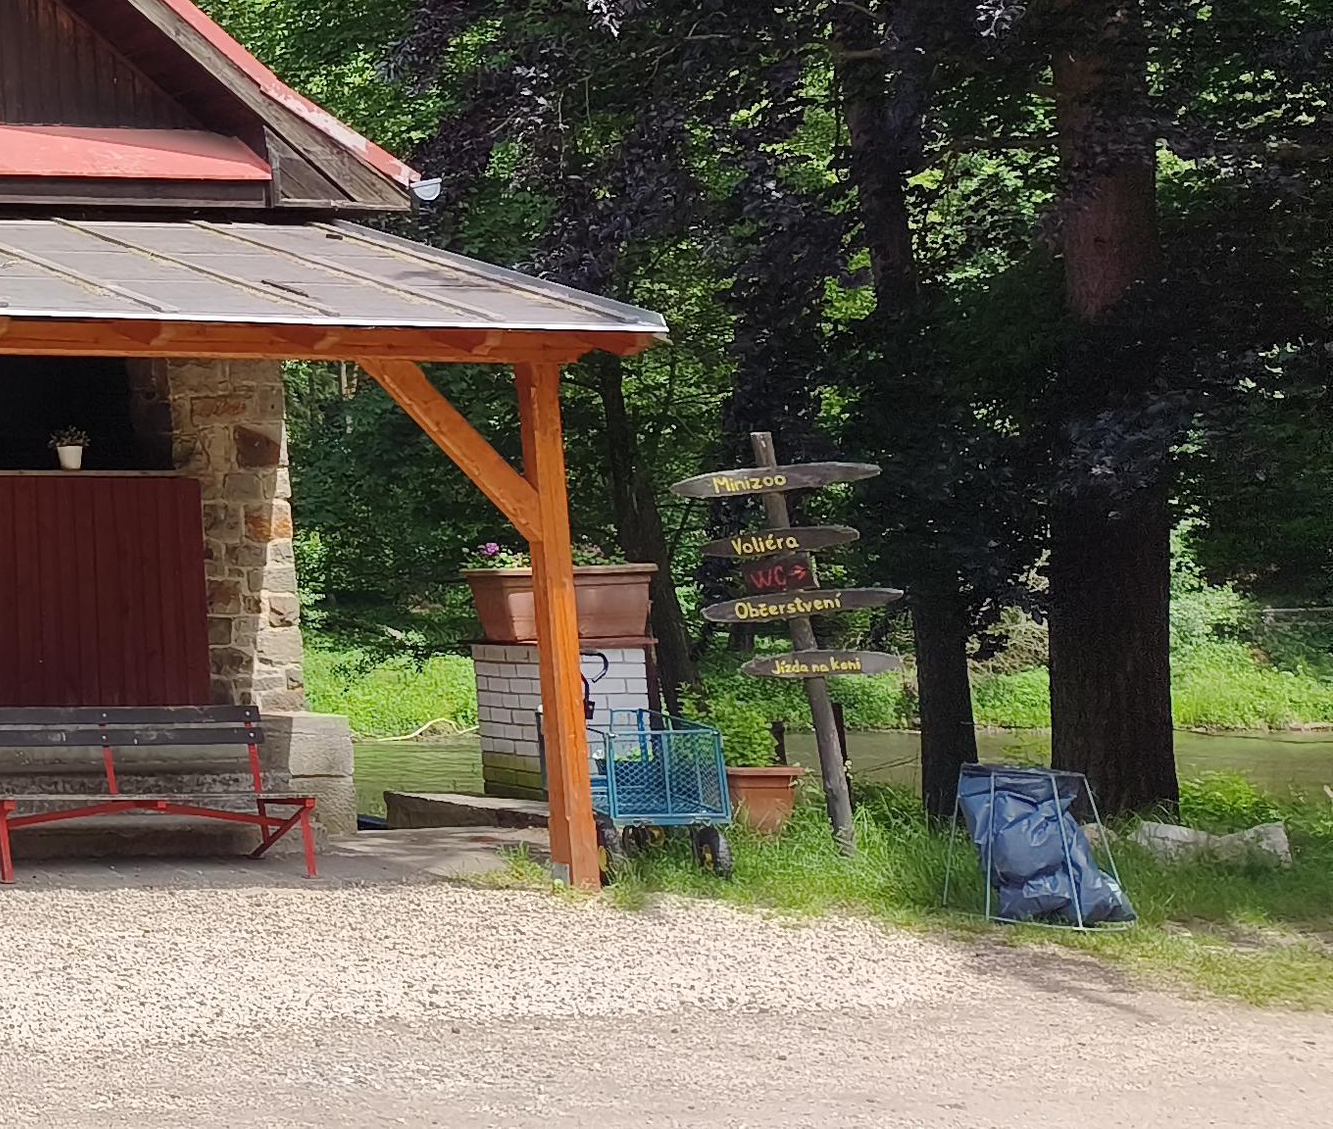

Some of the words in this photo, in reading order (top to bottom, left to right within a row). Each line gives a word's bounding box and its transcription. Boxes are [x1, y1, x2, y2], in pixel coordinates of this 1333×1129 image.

[712, 474, 787, 494] Minizoo
[731, 533, 800, 556] Voliéra
[750, 565, 787, 589] WC
[734, 592, 842, 620] Občerstvení
[771, 659, 809, 675] Jízda
[811, 664, 830, 673] na
[829, 656, 862, 671] koni
